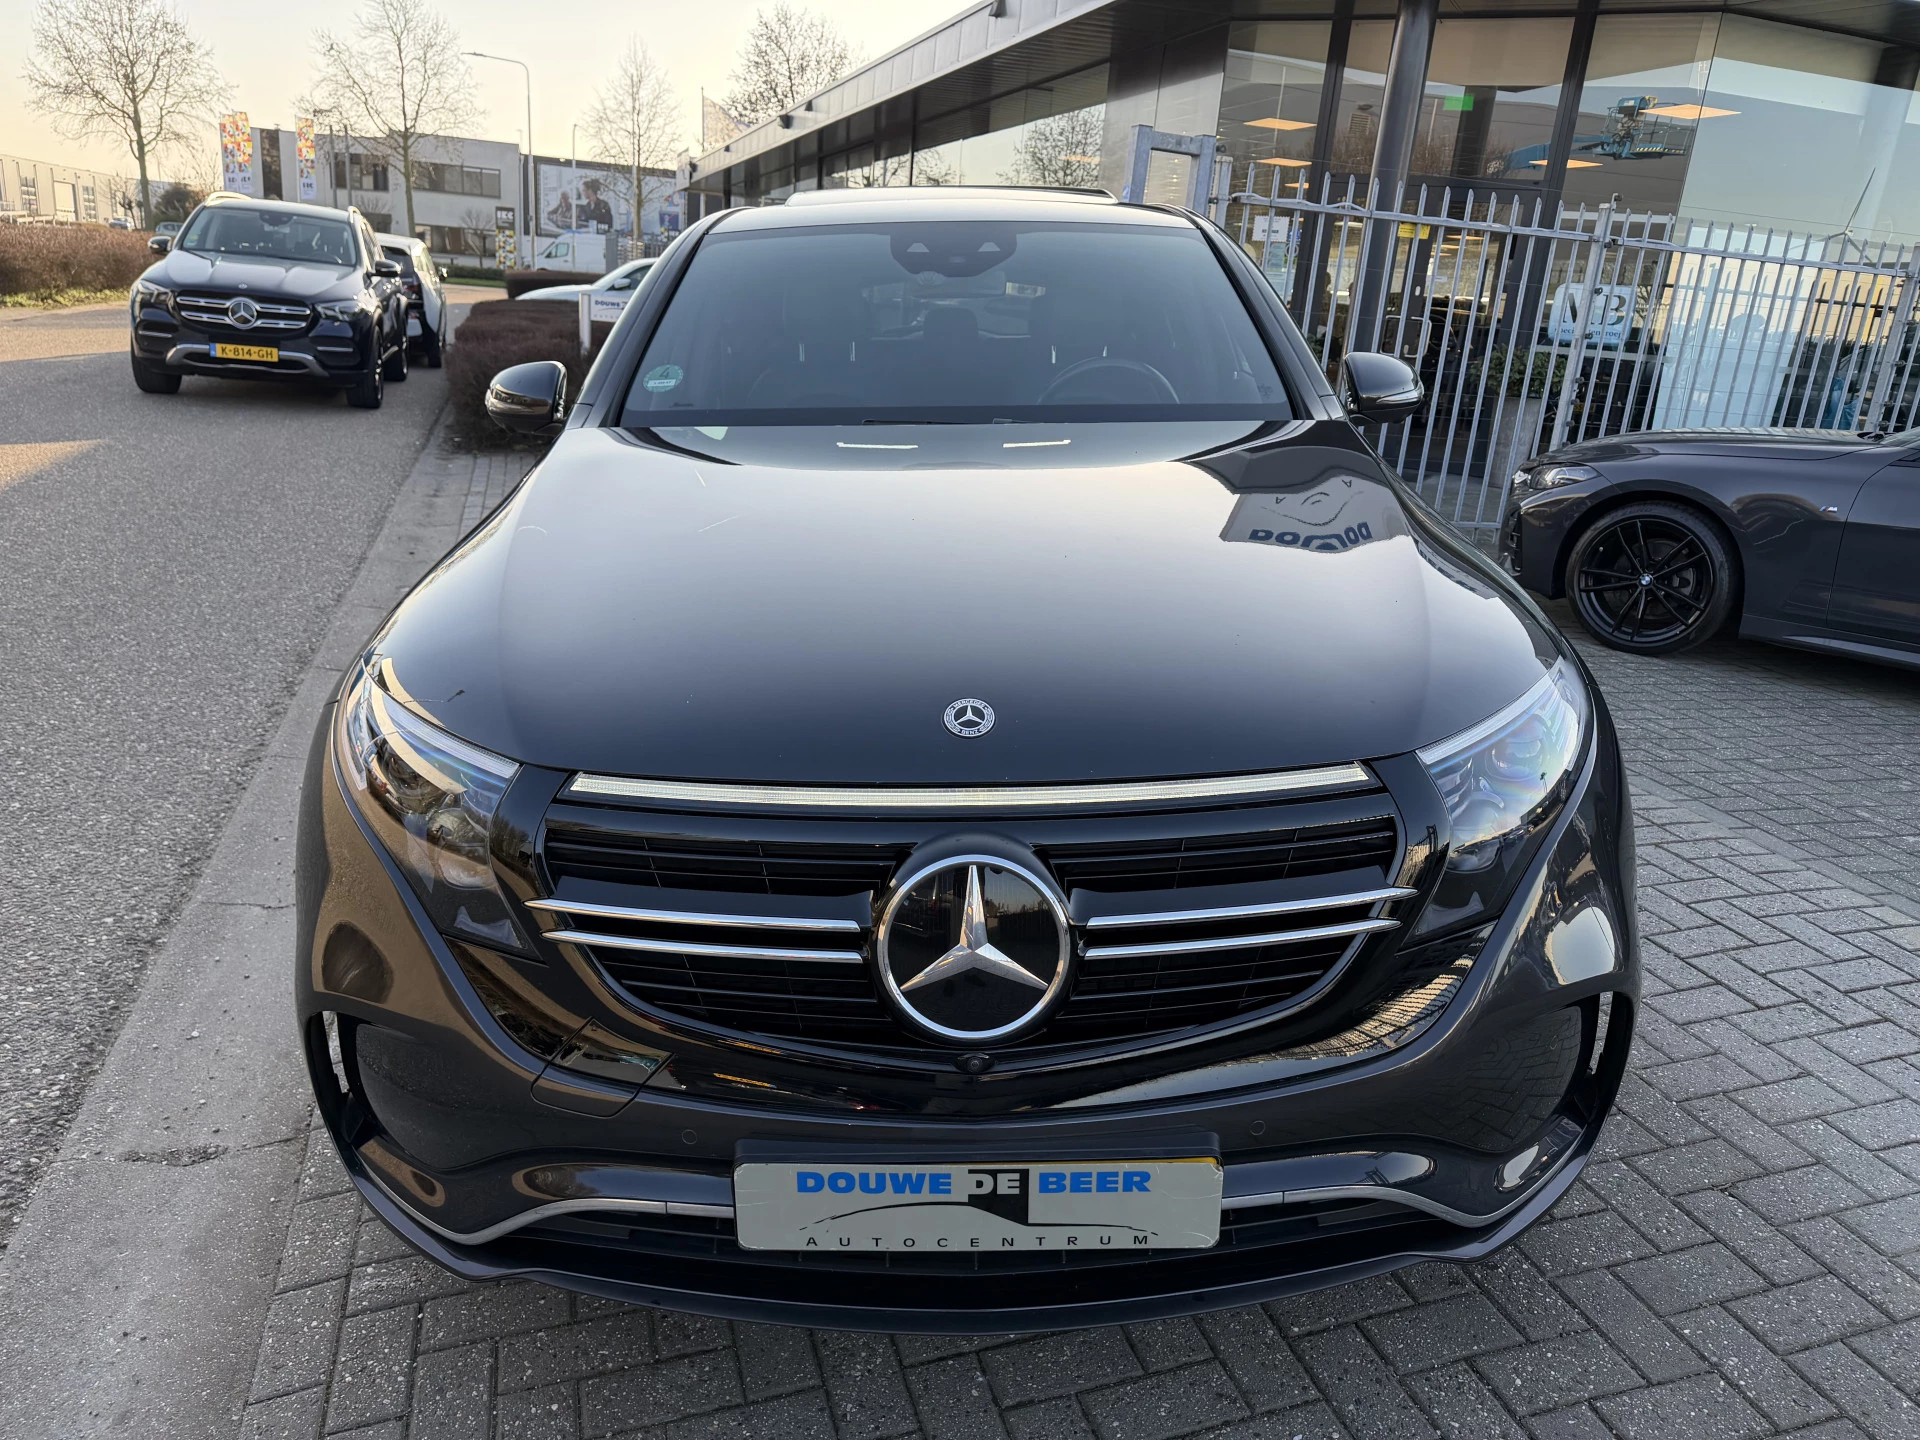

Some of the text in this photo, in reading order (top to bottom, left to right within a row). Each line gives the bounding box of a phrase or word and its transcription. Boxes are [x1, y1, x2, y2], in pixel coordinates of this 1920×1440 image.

[221, 346, 273, 359] K-814-GH
[658, 366, 671, 379] 4
[796, 1171, 1152, 1195] DOUWE DE BEER
[805, 1235, 1149, 1249] AUTOCENTRUM
